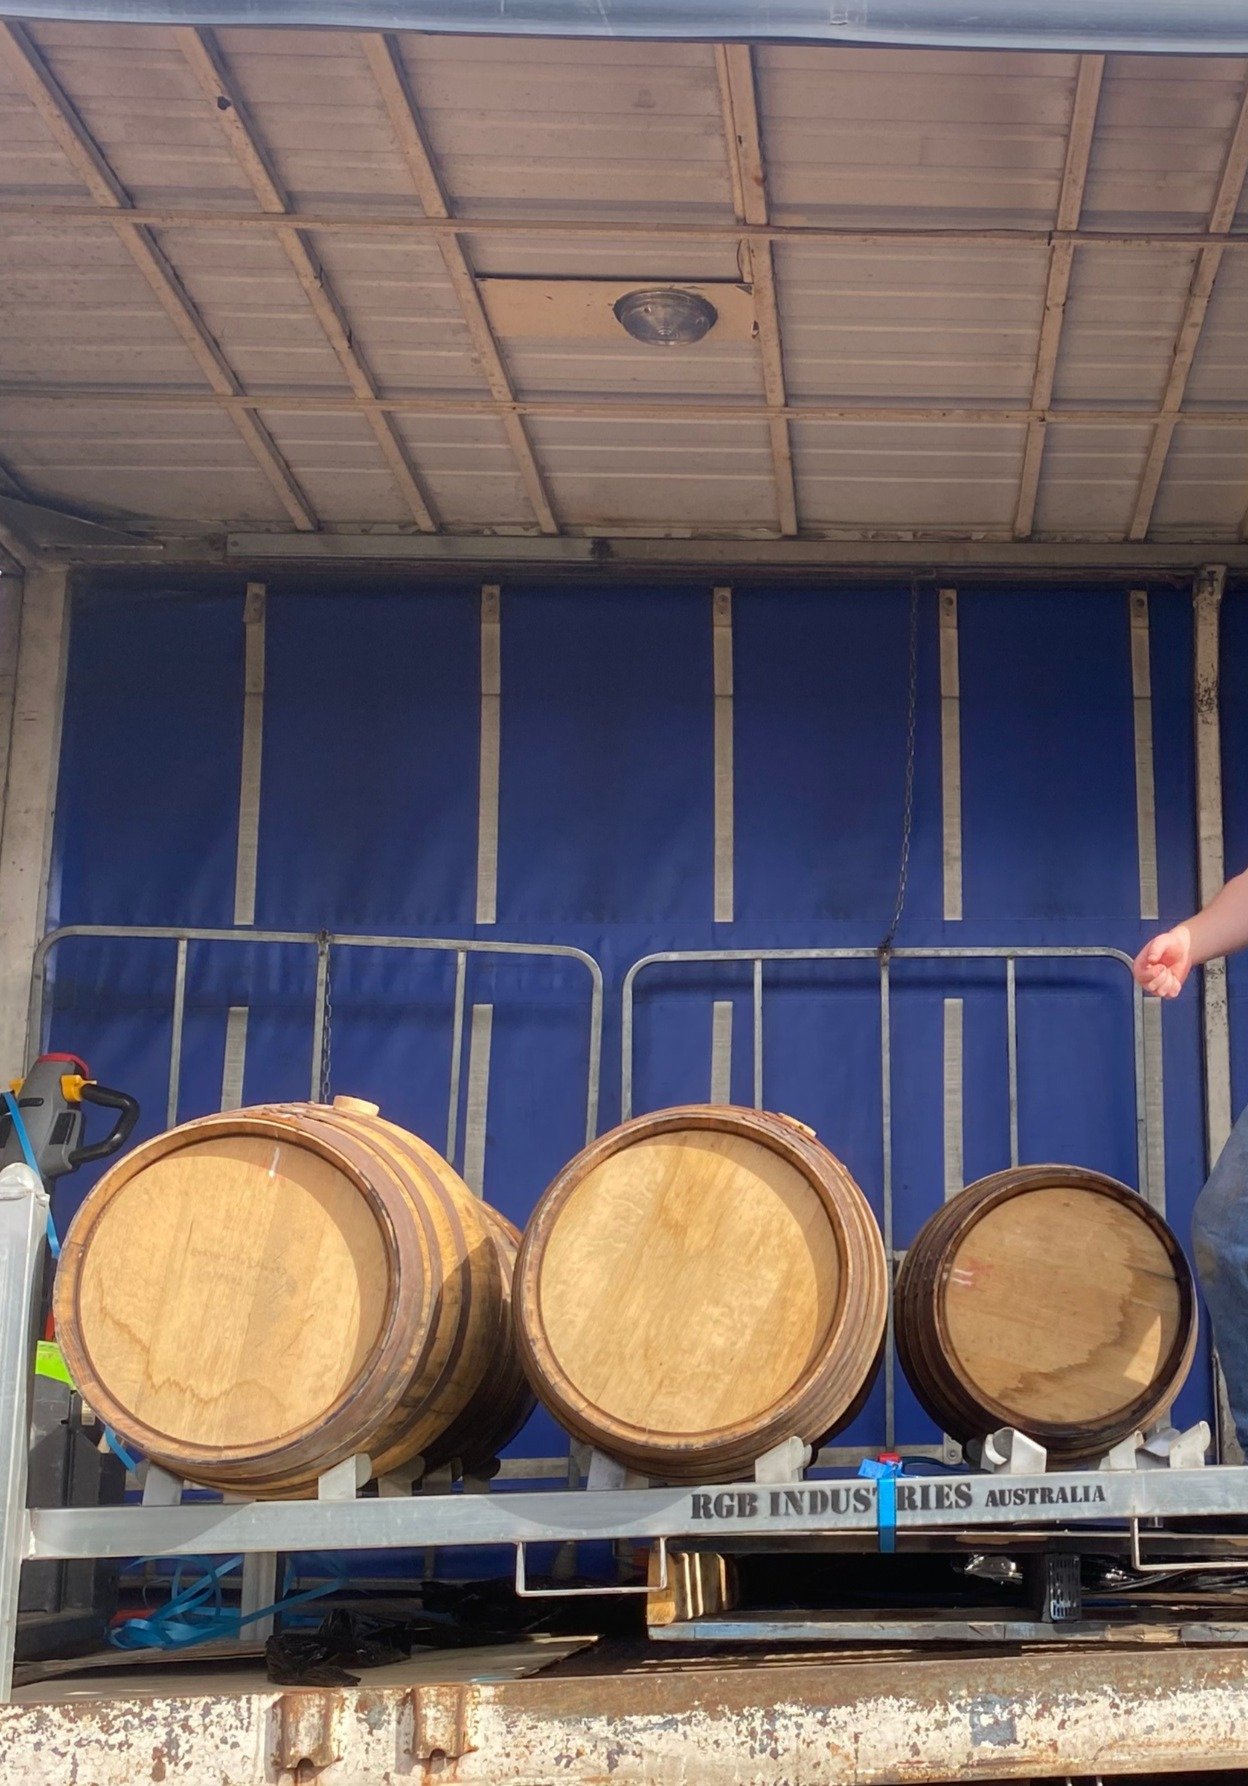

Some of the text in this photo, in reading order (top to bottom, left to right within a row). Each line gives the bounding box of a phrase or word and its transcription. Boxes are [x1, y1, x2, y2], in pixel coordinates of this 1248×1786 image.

[690, 1482, 1107, 1520] RGB INDUSRIES AUSTRALIA
